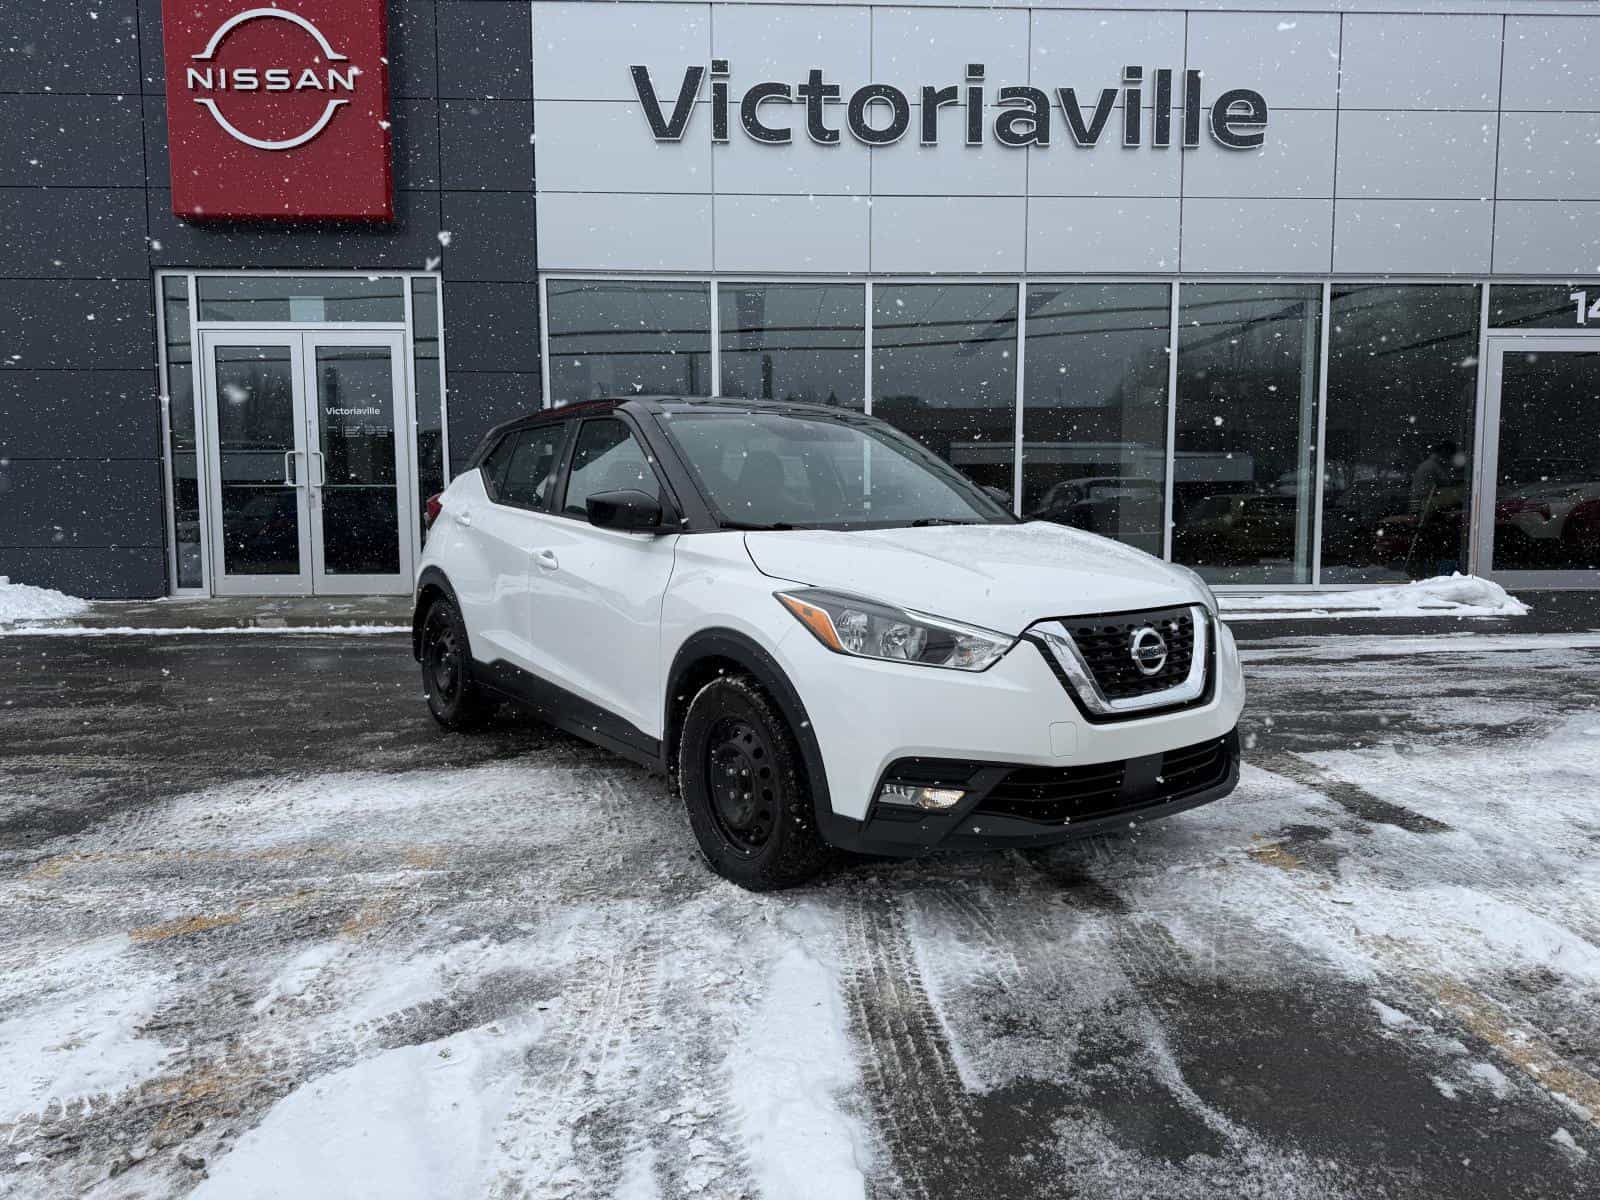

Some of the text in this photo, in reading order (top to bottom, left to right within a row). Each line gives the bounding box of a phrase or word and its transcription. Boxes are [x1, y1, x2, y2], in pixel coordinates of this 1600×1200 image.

[186, 67, 354, 91] NISSAN
[629, 59, 1268, 150] Victoriaville
[325, 407, 381, 415] Victoriaville
